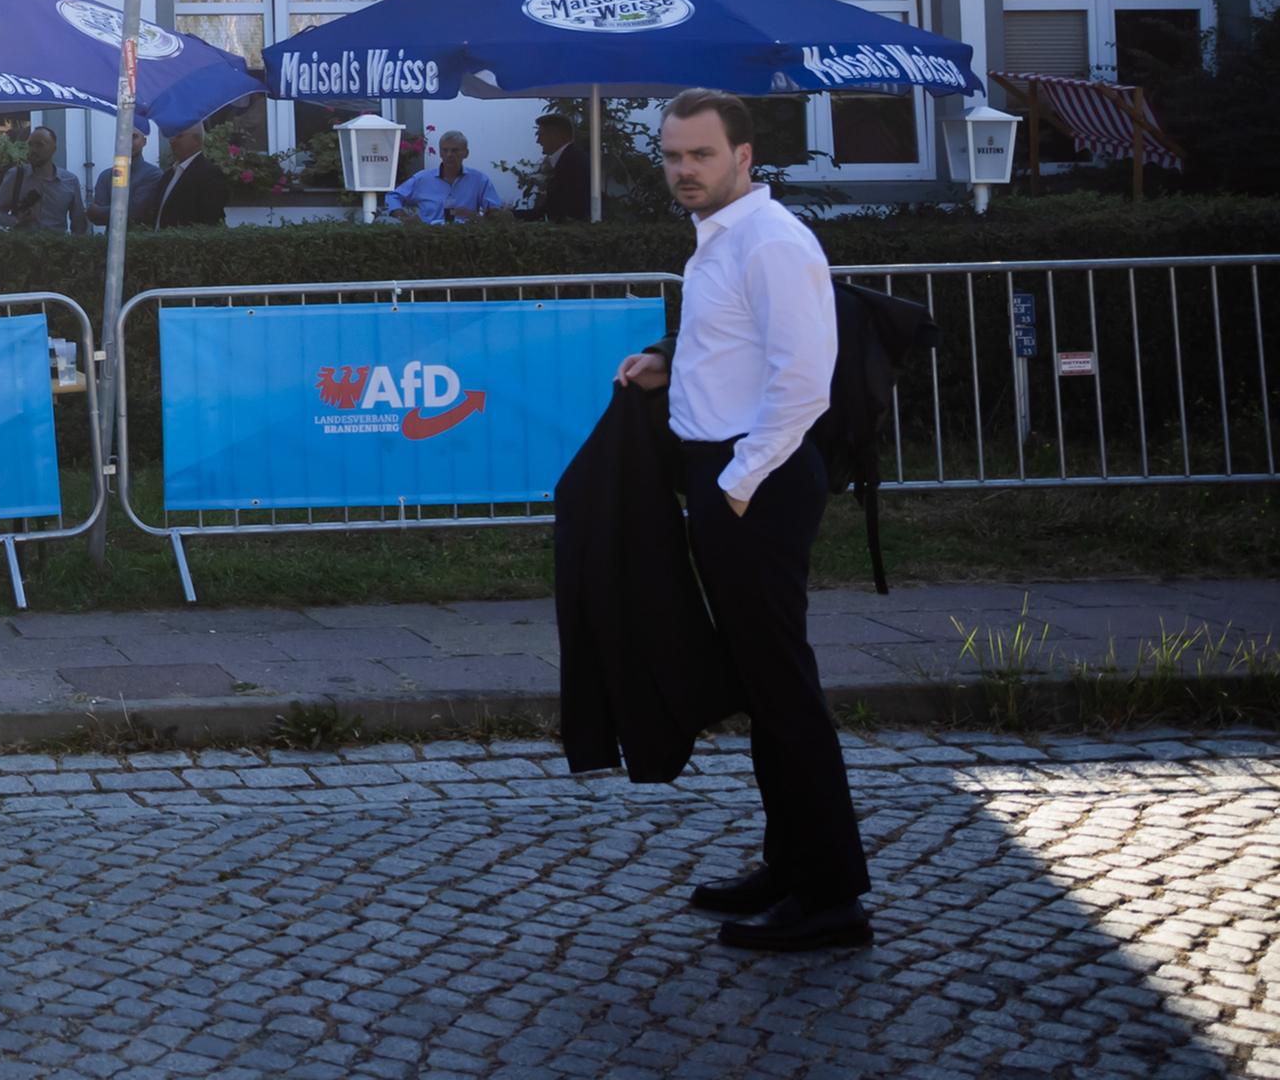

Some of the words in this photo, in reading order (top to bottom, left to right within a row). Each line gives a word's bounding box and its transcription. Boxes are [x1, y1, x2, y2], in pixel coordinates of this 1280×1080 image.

[280, 50, 360, 97] Maisel's
[367, 49, 439, 96] Weisse
[881, 44, 967, 88] Weisse
[361, 360, 461, 409] AfD
[314, 414, 399, 424] LANDESVERBAND
[324, 424, 400, 434] BRANDENBURG
